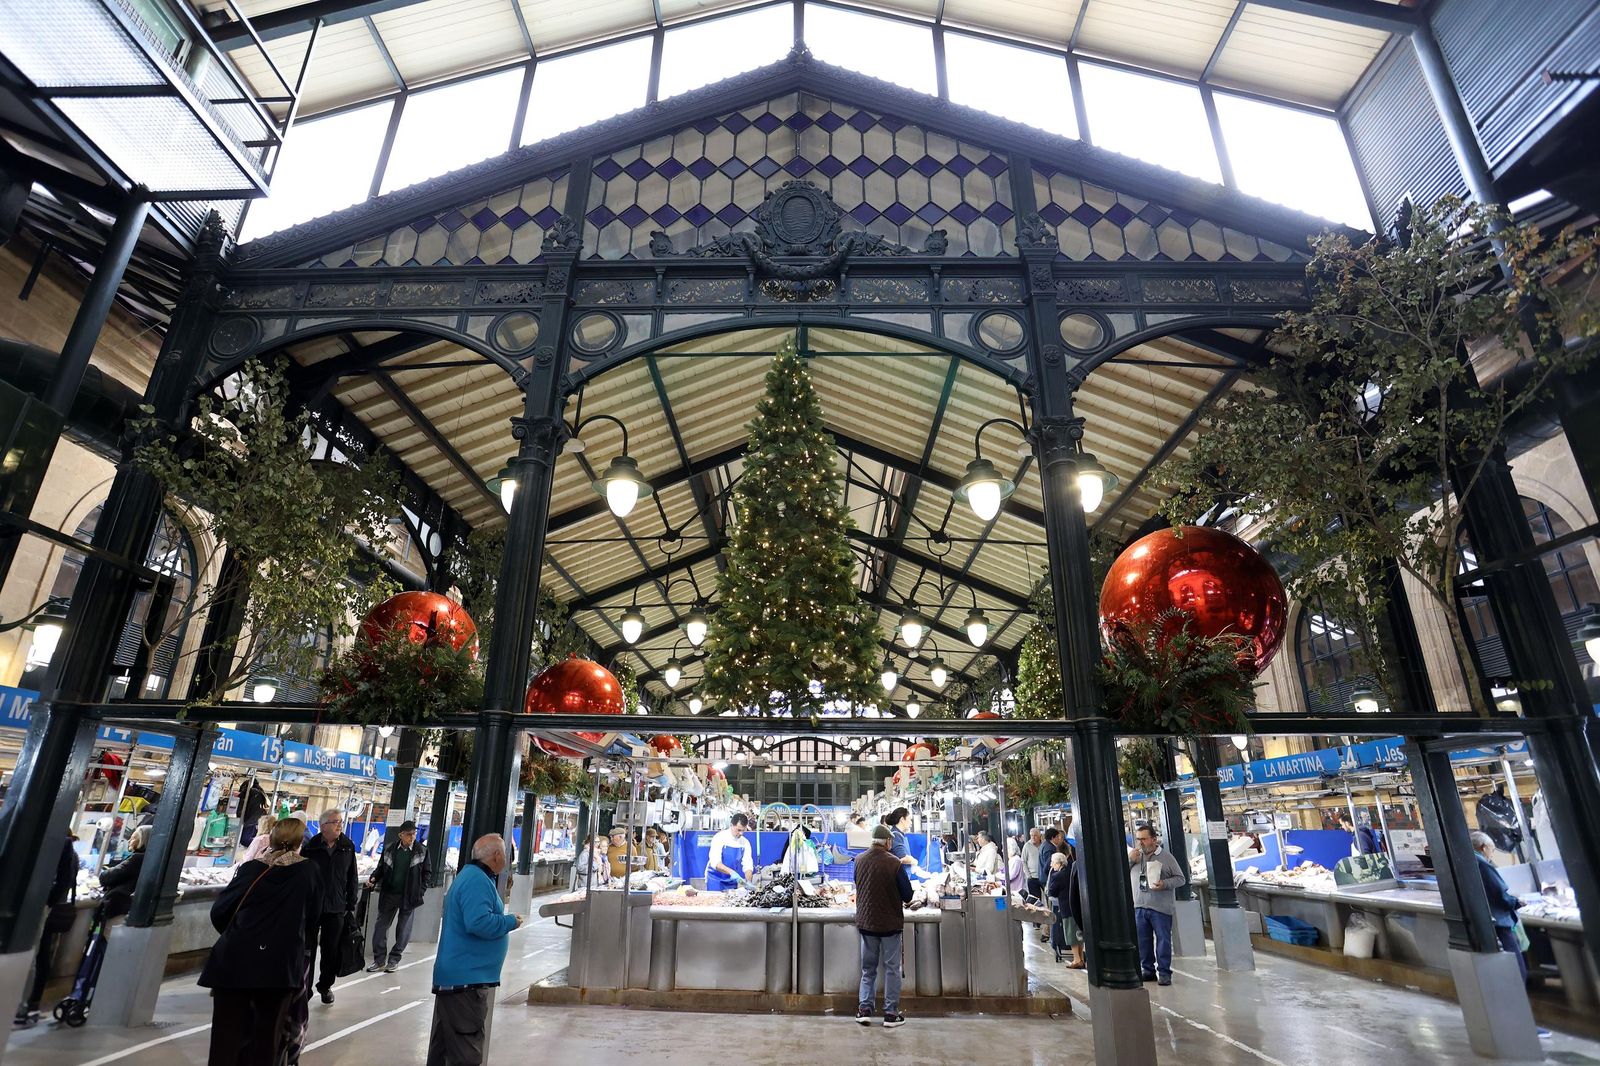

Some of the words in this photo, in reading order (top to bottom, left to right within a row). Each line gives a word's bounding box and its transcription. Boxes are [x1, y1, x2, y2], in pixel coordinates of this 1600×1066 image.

[261, 737, 282, 762] 15
[1375, 744, 1408, 763] J.Jes
[303, 749, 345, 770] M.Segura
[361, 757, 375, 777] 16
[1217, 766, 1236, 783] SUR
[1244, 763, 1254, 784] 5
[1263, 763, 1278, 778] LA
[1278, 755, 1325, 776] MARTINA
